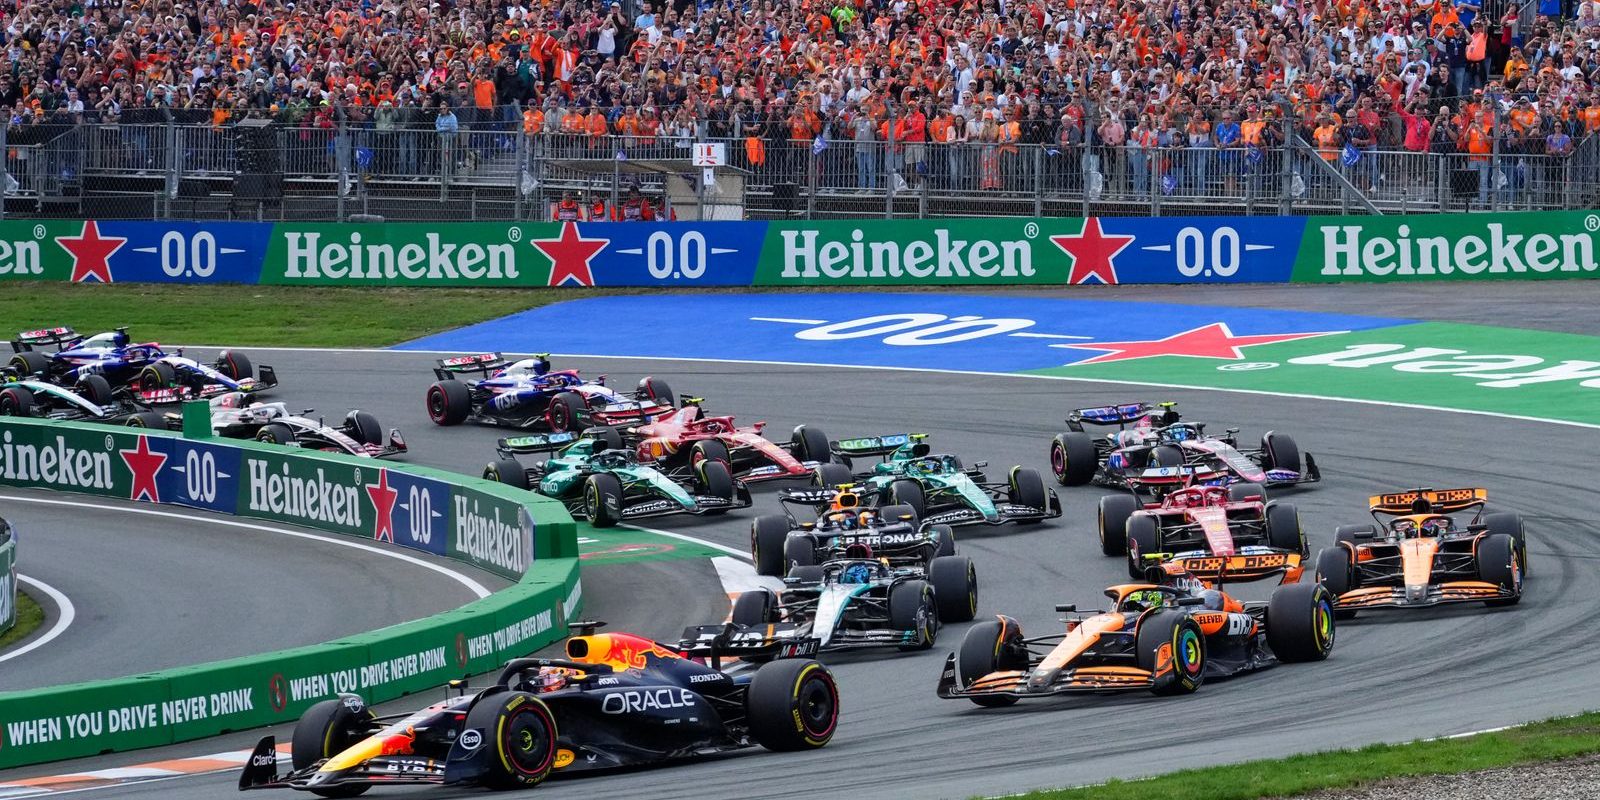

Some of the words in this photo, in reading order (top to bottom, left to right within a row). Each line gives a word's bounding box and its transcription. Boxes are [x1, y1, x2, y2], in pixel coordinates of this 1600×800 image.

[161, 231, 216, 277] 0.0
[284, 231, 520, 279] Heineken
[647, 230, 706, 279] 0.0
[780, 228, 1036, 278] Heineken
[1176, 226, 1240, 277] 0.0
[1320, 223, 1599, 275] Heineken
[186, 449, 216, 503] 0.0
[248, 459, 361, 528] Heineken
[409, 485, 431, 544] 0.0
[455, 495, 523, 573] Heineken
[468, 634, 493, 659] WHEN
[780, 644, 807, 658] Mobil
[290, 674, 329, 701] WHEN
[331, 668, 358, 694] YOU
[361, 664, 388, 689] DRIVE
[390, 655, 418, 681] NEVER
[419, 646, 447, 672] DRINK
[690, 673, 724, 683] HONDA
[8, 717, 62, 746] WHEN
[65, 711, 103, 738] YOU
[108, 704, 157, 733] DRIVE
[162, 697, 208, 725] NEVER
[211, 687, 254, 716] DRINK
[601, 688, 695, 715] ORACLE
[252, 752, 275, 767] Claro
[463, 735, 479, 744] Esso
